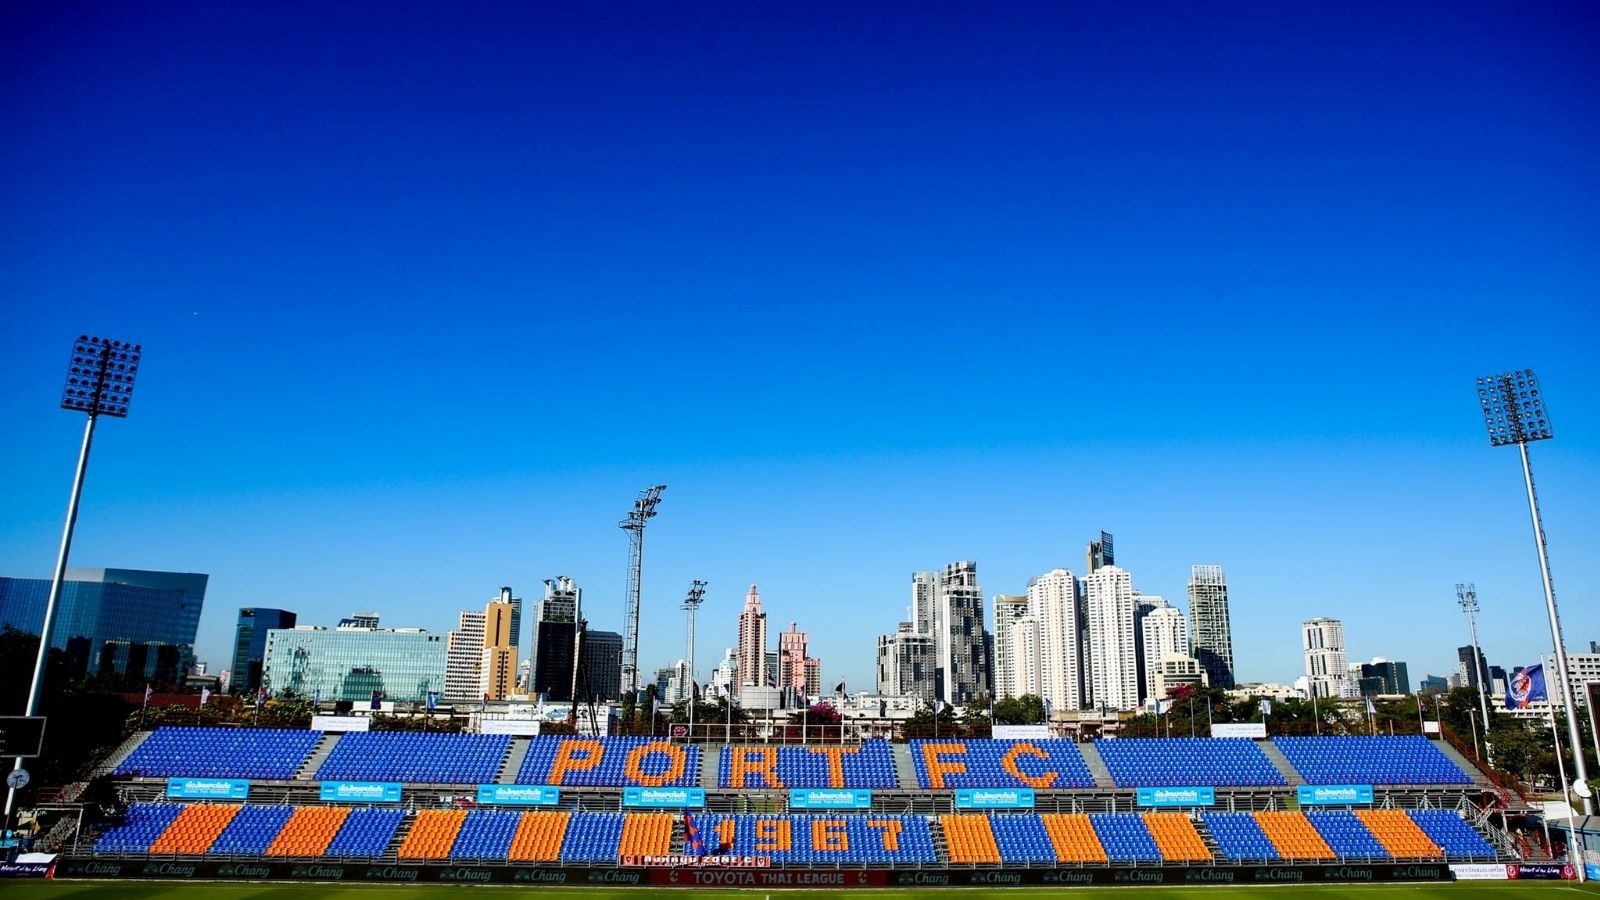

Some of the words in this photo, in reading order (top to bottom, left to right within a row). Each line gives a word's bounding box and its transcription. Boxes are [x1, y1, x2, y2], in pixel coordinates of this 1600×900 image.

[549, 740, 859, 788] PORT
[921, 743, 1058, 788] FC
[715, 819, 902, 851] 1967
[85, 862, 121, 875] Chang
[160, 863, 195, 876] Chang
[234, 863, 270, 877] Chang
[308, 865, 344, 879] Chang
[383, 867, 418, 880] Chang
[456, 868, 491, 882] Chang
[1270, 868, 1303, 882] Chang
[1340, 867, 1373, 880] Chang
[1408, 866, 1440, 879] Chang
[531, 869, 566, 882] Chang
[604, 871, 640, 884] Chang
[694, 872, 756, 884] TOYOTA
[761, 873, 792, 884] THAI
[797, 873, 844, 884] LEAGUE
[914, 872, 949, 885] Chang
[987, 872, 1022, 885] Chang
[1059, 870, 1093, 883] Chang
[1130, 870, 1164, 883] Chang
[1201, 870, 1234, 882] Chang
